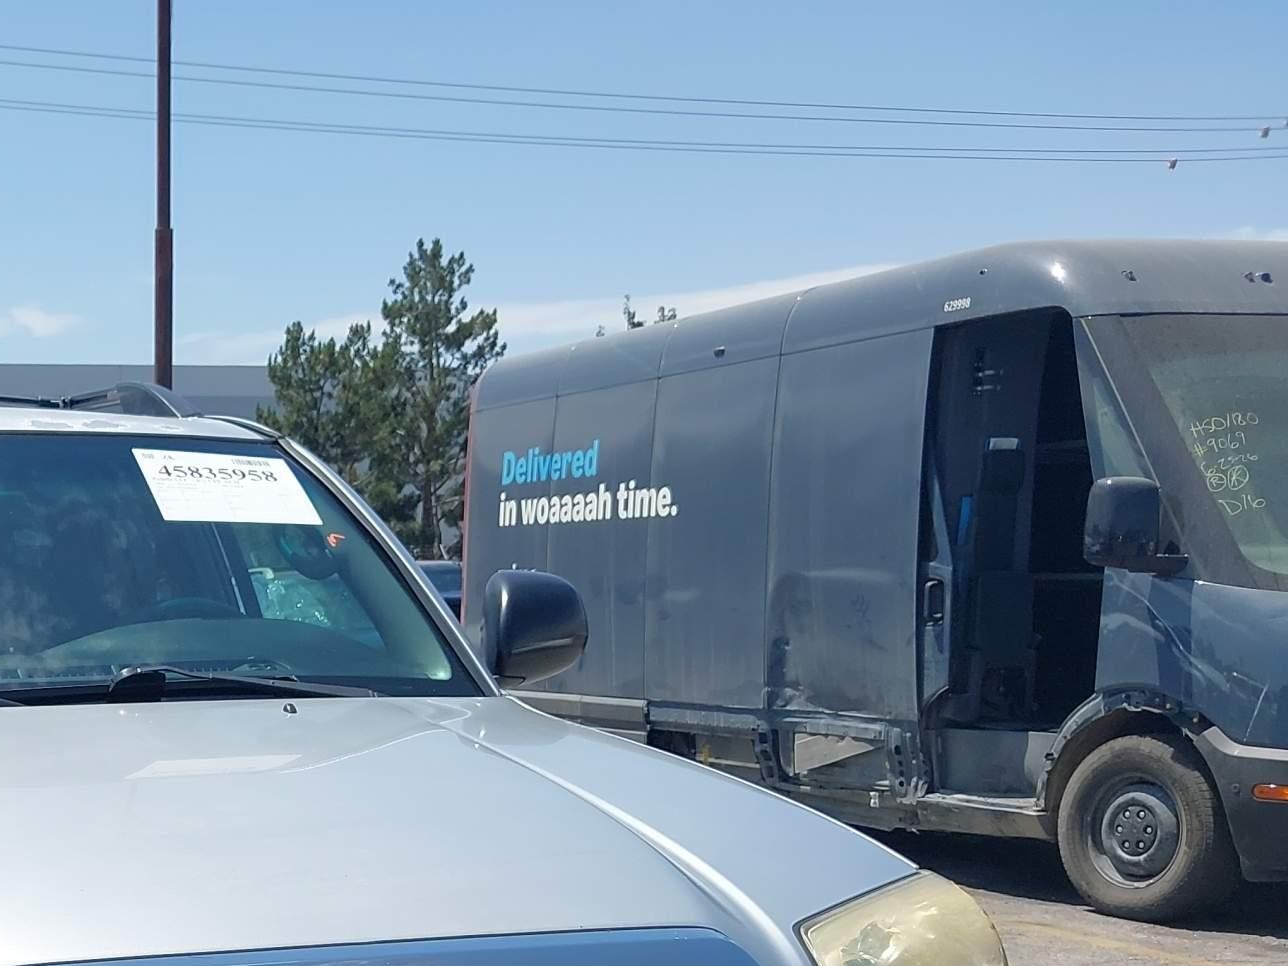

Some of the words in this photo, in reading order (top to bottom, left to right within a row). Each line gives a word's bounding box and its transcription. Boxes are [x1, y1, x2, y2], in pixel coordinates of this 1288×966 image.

[158, 464, 278, 482] 45835958
[502, 439, 600, 485] Delivered
[498, 492, 516, 527] in
[521, 483, 612, 525] woaaaah
[617, 480, 679, 519] time.
